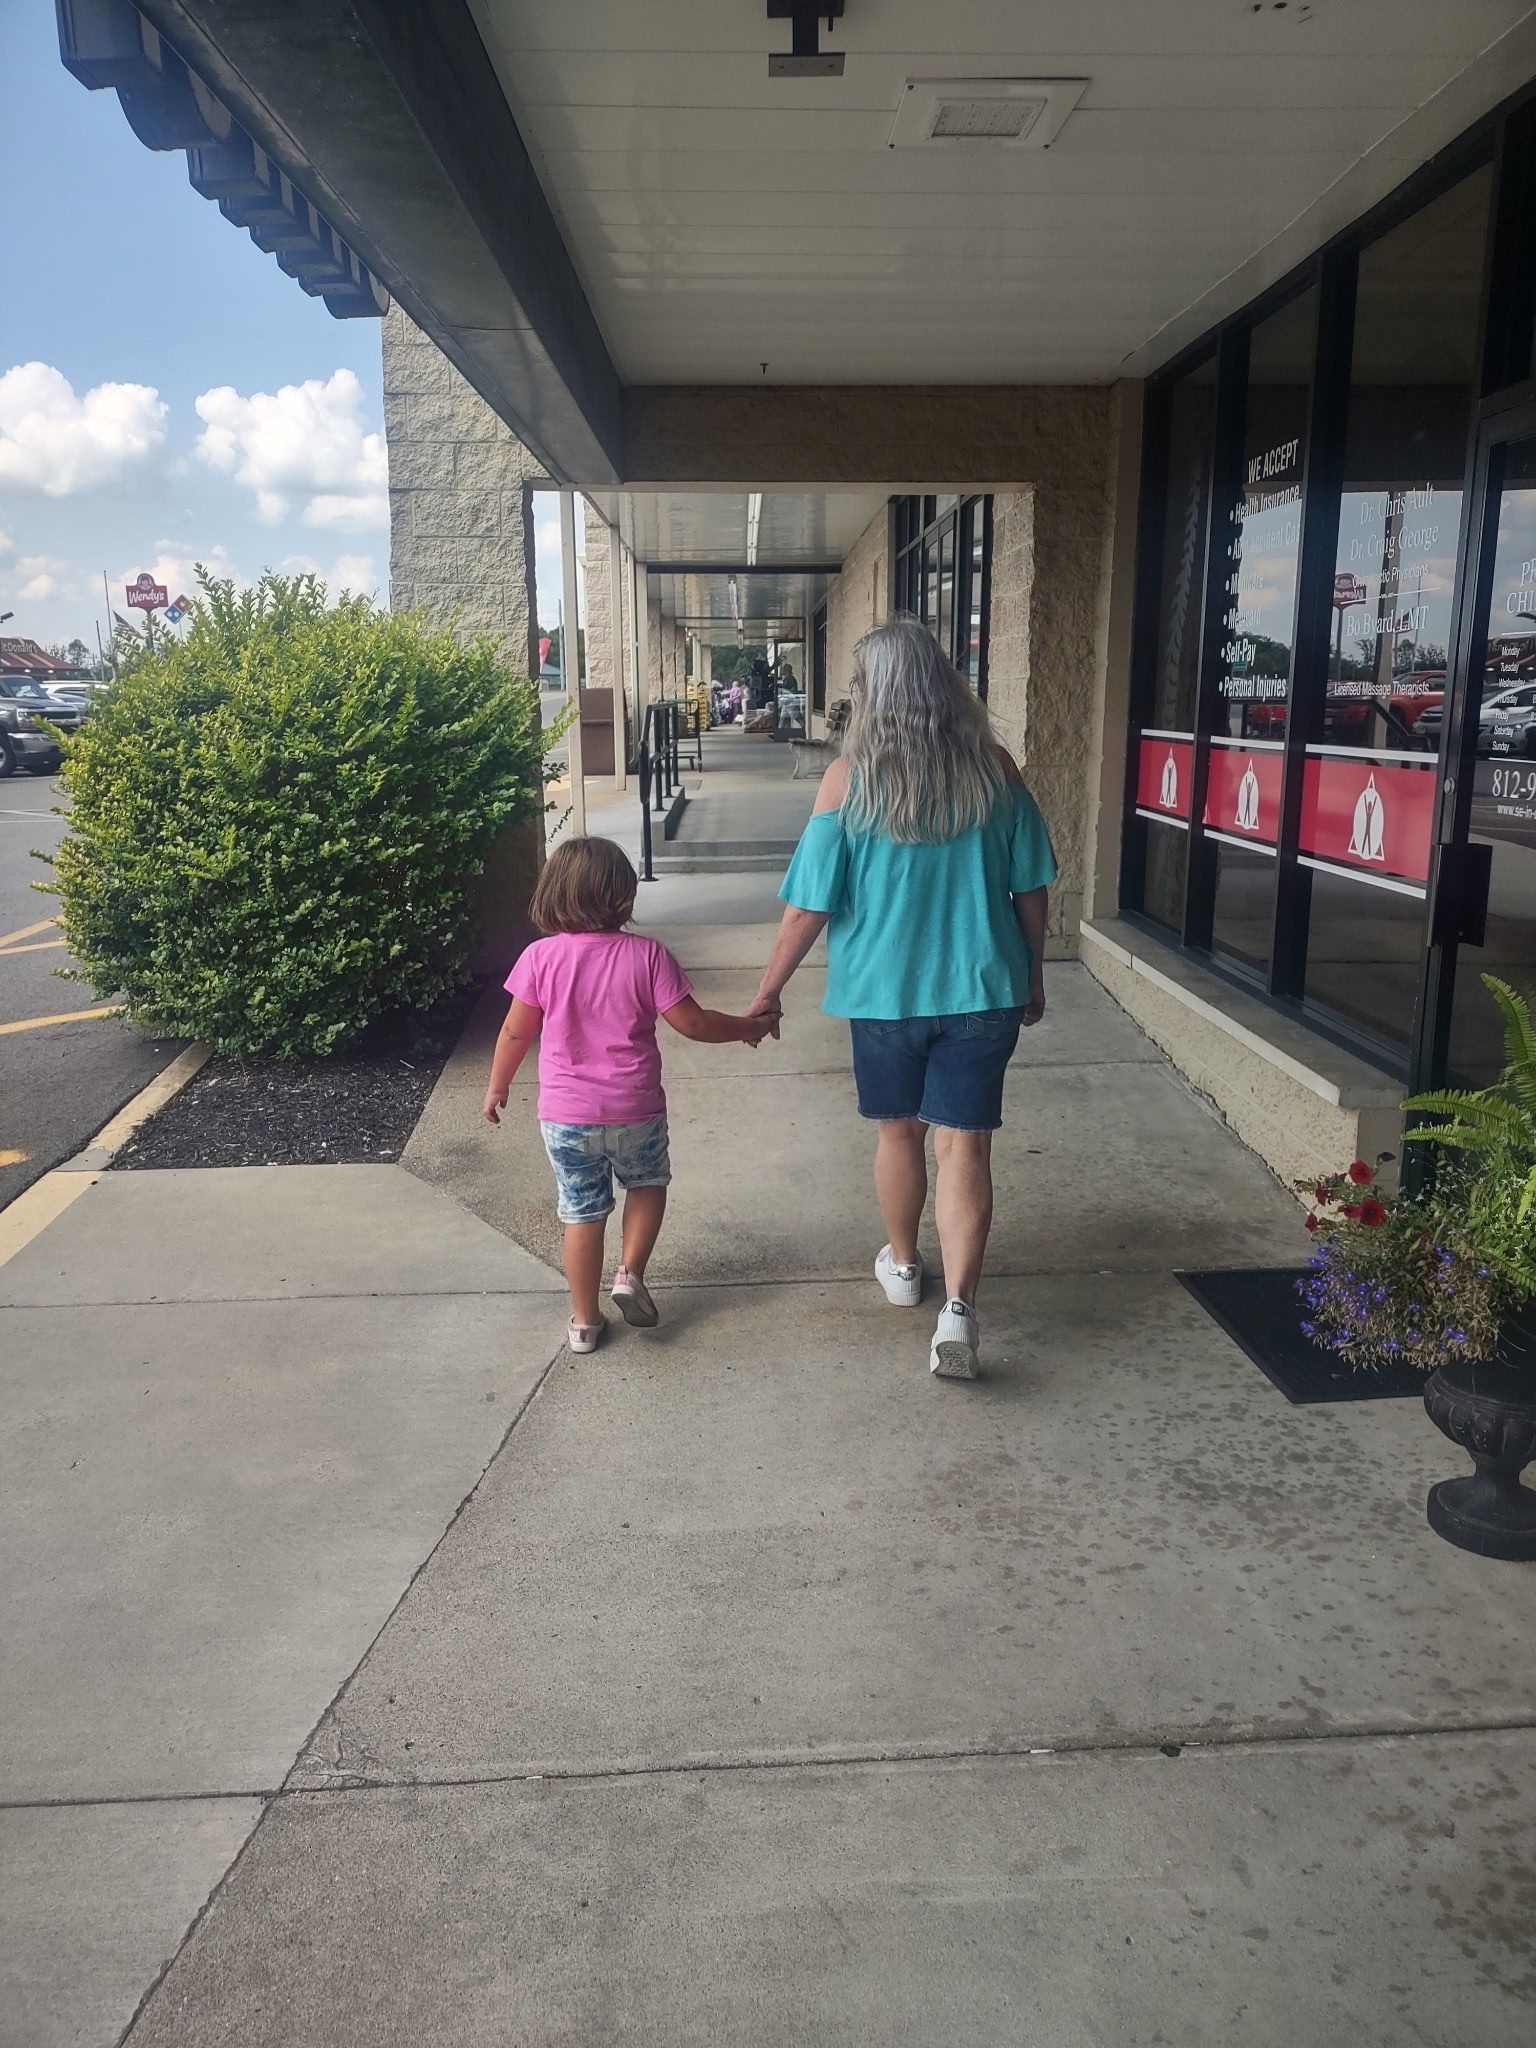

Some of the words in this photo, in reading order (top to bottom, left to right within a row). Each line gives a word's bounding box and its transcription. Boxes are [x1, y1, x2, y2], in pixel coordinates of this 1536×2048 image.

[1248, 455, 1262, 485] WE
[1262, 438, 1299, 479] ACCEPT
[1234, 495, 1259, 525] Health
[1260, 484, 1300, 512] Insurance
[1360, 502, 1375, 525] Dr.
[1379, 492, 1406, 519] Chris
[1408, 481, 1434, 511] Ault
[1351, 538, 1365, 561] Dr.
[1367, 530, 1396, 559] Craig
[1399, 525, 1439, 551] George
[128, 589, 165, 605] Wendy's
[1346, 615, 1361, 638] Bo
[1399, 605, 1430, 631] LMT
[1226, 637, 1257, 667] Self-Pay
[1501, 646, 1520, 658] Monday
[1500, 662, 1519, 674] Tuesday
[1223, 674, 1256, 698] Personal
[1256, 673, 1287, 702] Injuries
[1334, 681, 1361, 697] Licensed
[1361, 681, 1391, 699] Massage
[1392, 680, 1430, 699] Therapists
[1495, 711, 1510, 722] Friday
[1493, 725, 1514, 738] Saturday
[1492, 741, 1510, 754] Sunday
